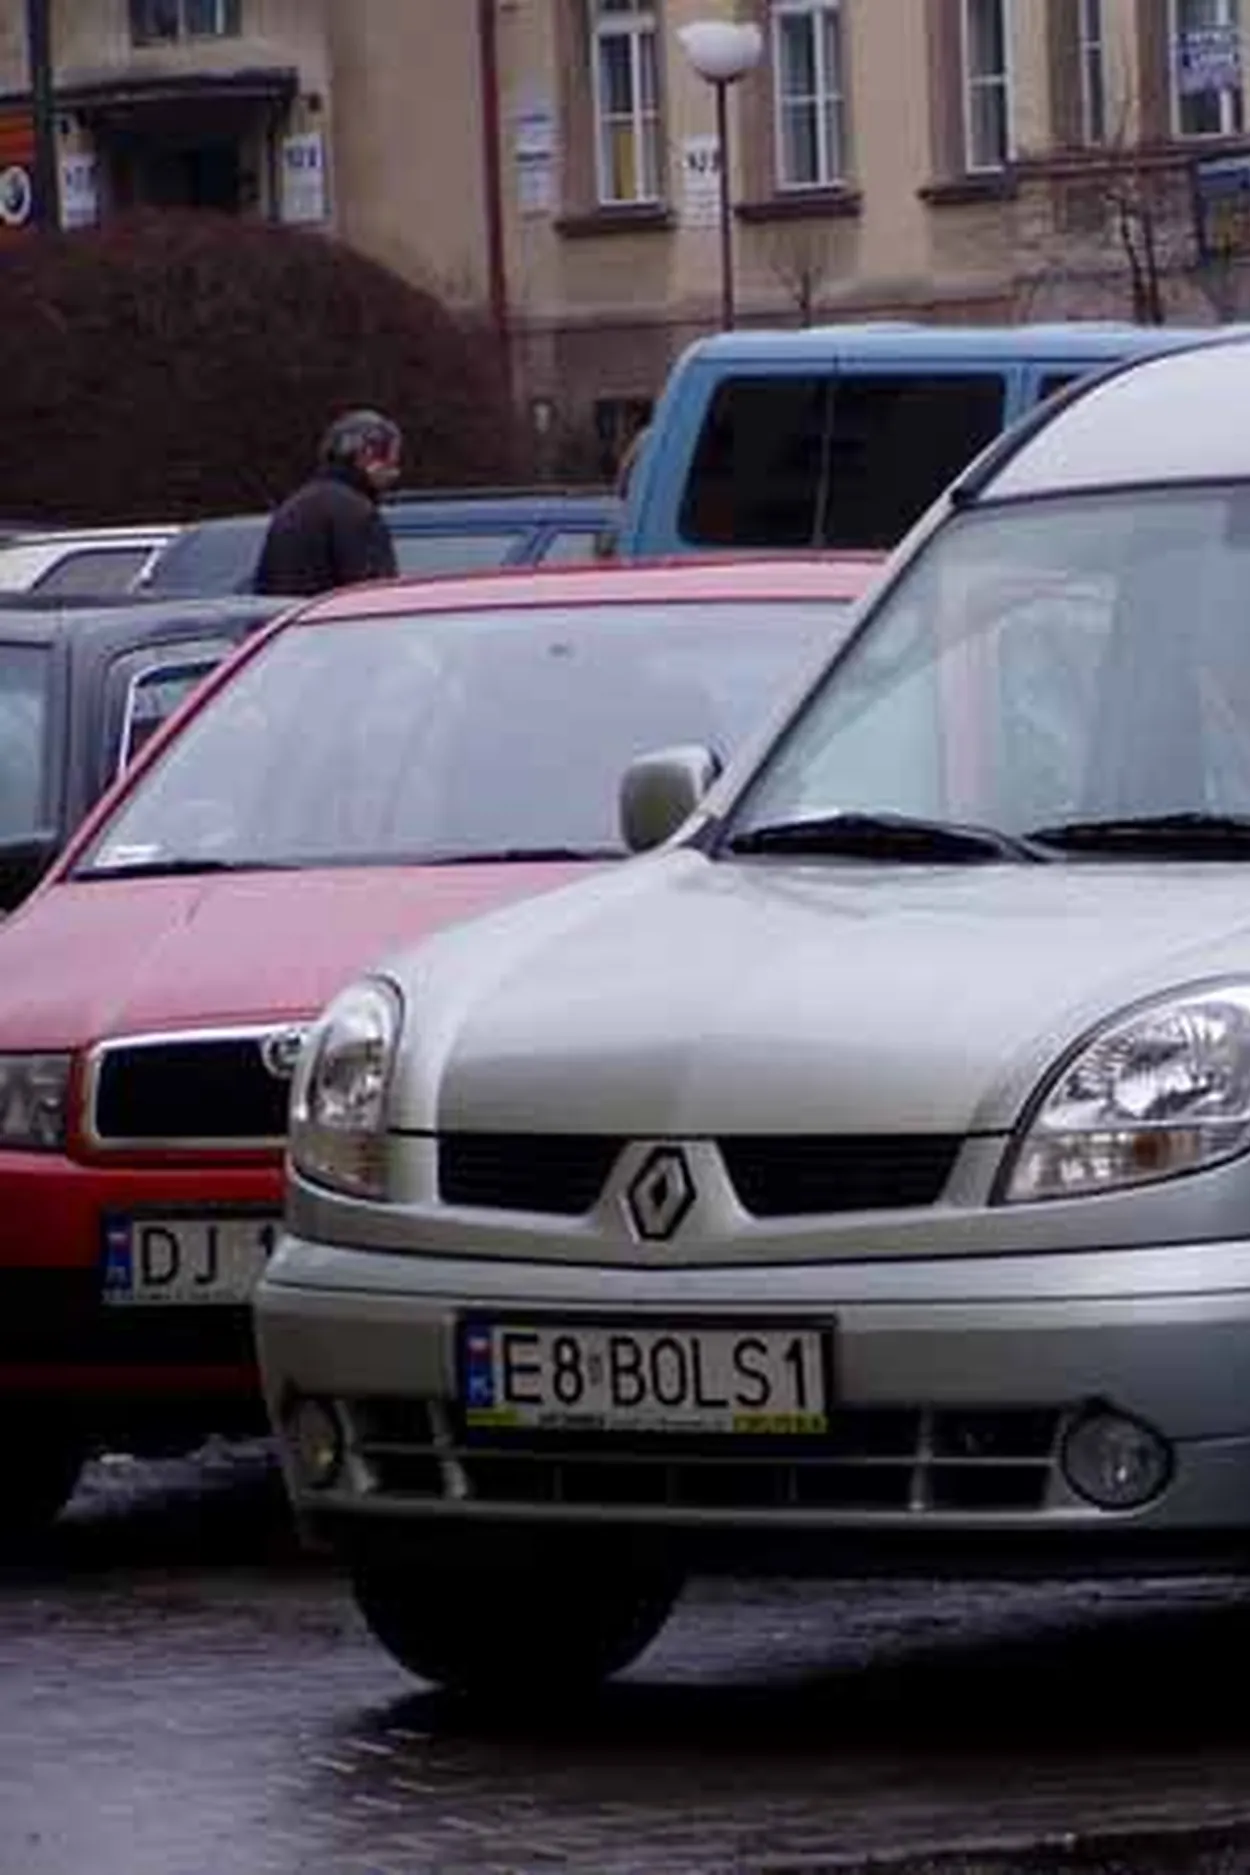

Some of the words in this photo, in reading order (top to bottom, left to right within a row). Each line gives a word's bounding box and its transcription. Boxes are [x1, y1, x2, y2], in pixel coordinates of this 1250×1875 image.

[141, 1226, 218, 1285] DJ
[503, 1333, 584, 1405] E8
[609, 1335, 807, 1408] BOLS1
